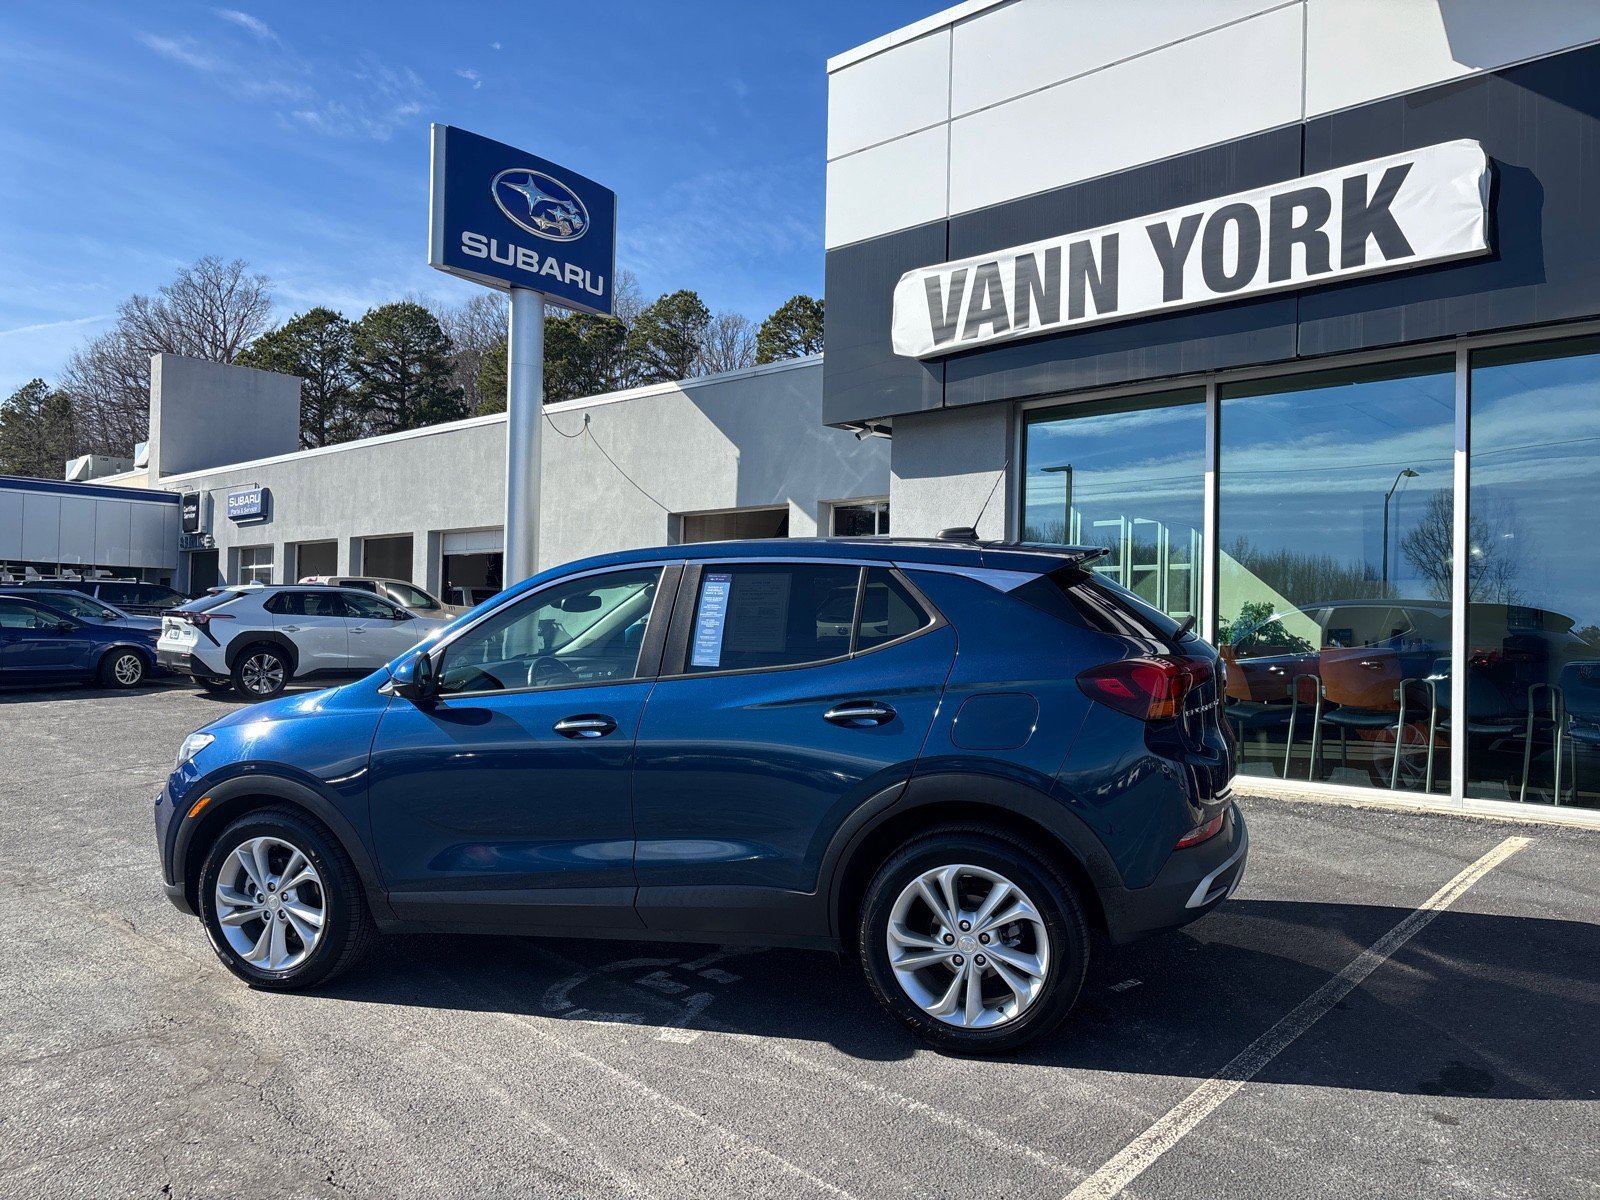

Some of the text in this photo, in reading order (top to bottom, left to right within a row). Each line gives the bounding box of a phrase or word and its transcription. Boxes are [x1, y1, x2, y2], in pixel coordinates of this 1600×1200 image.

[461, 230, 604, 296] SUBARU
[924, 162, 1416, 346] VANN YORK
[229, 494, 260, 507] SUBARU
